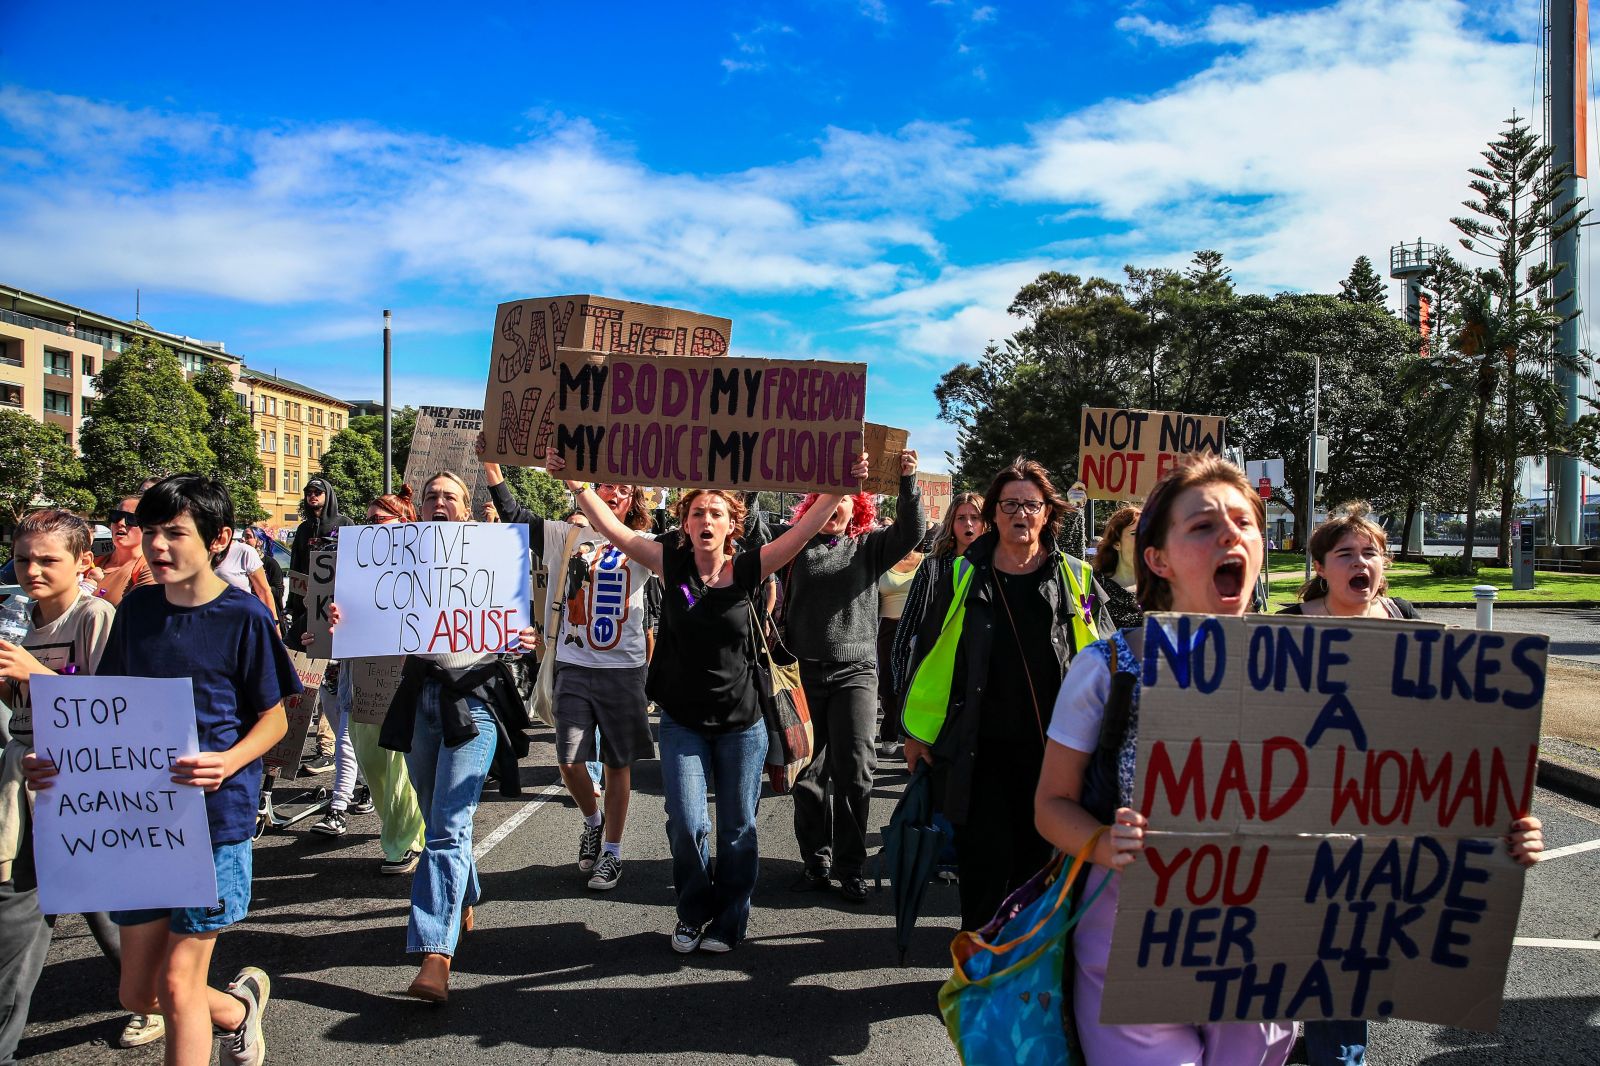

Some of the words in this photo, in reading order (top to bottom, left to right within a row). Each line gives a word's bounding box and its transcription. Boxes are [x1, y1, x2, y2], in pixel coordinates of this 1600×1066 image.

[421, 406, 454, 418] THEY
[559, 362, 608, 411] MY
[611, 362, 709, 420] BODY
[710, 368, 762, 416] MY
[763, 367, 866, 421] FREEDOM
[435, 418, 449, 428] BE
[453, 420, 482, 430] HERE
[1084, 410, 1149, 450] NOT
[1159, 415, 1224, 455] NOW
[557, 424, 605, 474] MY
[608, 422, 707, 481] CHOICE
[709, 426, 759, 484] MY
[760, 427, 860, 487] CHOICE
[1082, 452, 1145, 494] NOT
[356, 525, 478, 568] COERCIVE
[374, 567, 504, 610] CONTROL
[398, 613, 421, 653] IS
[427, 608, 518, 653] ABUSE
[1143, 616, 1227, 694] NO
[1248, 624, 1353, 695] ONE
[1392, 631, 1547, 709] LIKES
[53, 696, 128, 729] STOP
[1305, 694, 1368, 751] A
[47, 746, 179, 776] VIOLENCE
[1141, 736, 1309, 822] MAD
[1330, 744, 1538, 828] WOMAN
[58, 790, 178, 817] AGAINST
[61, 826, 185, 857] WOMEN
[1143, 844, 1270, 907] YOU
[1304, 836, 1496, 912] MADE
[1137, 907, 1258, 969] HER
[1318, 901, 1482, 969] LIKE
[1195, 957, 1396, 1022] THAT.
